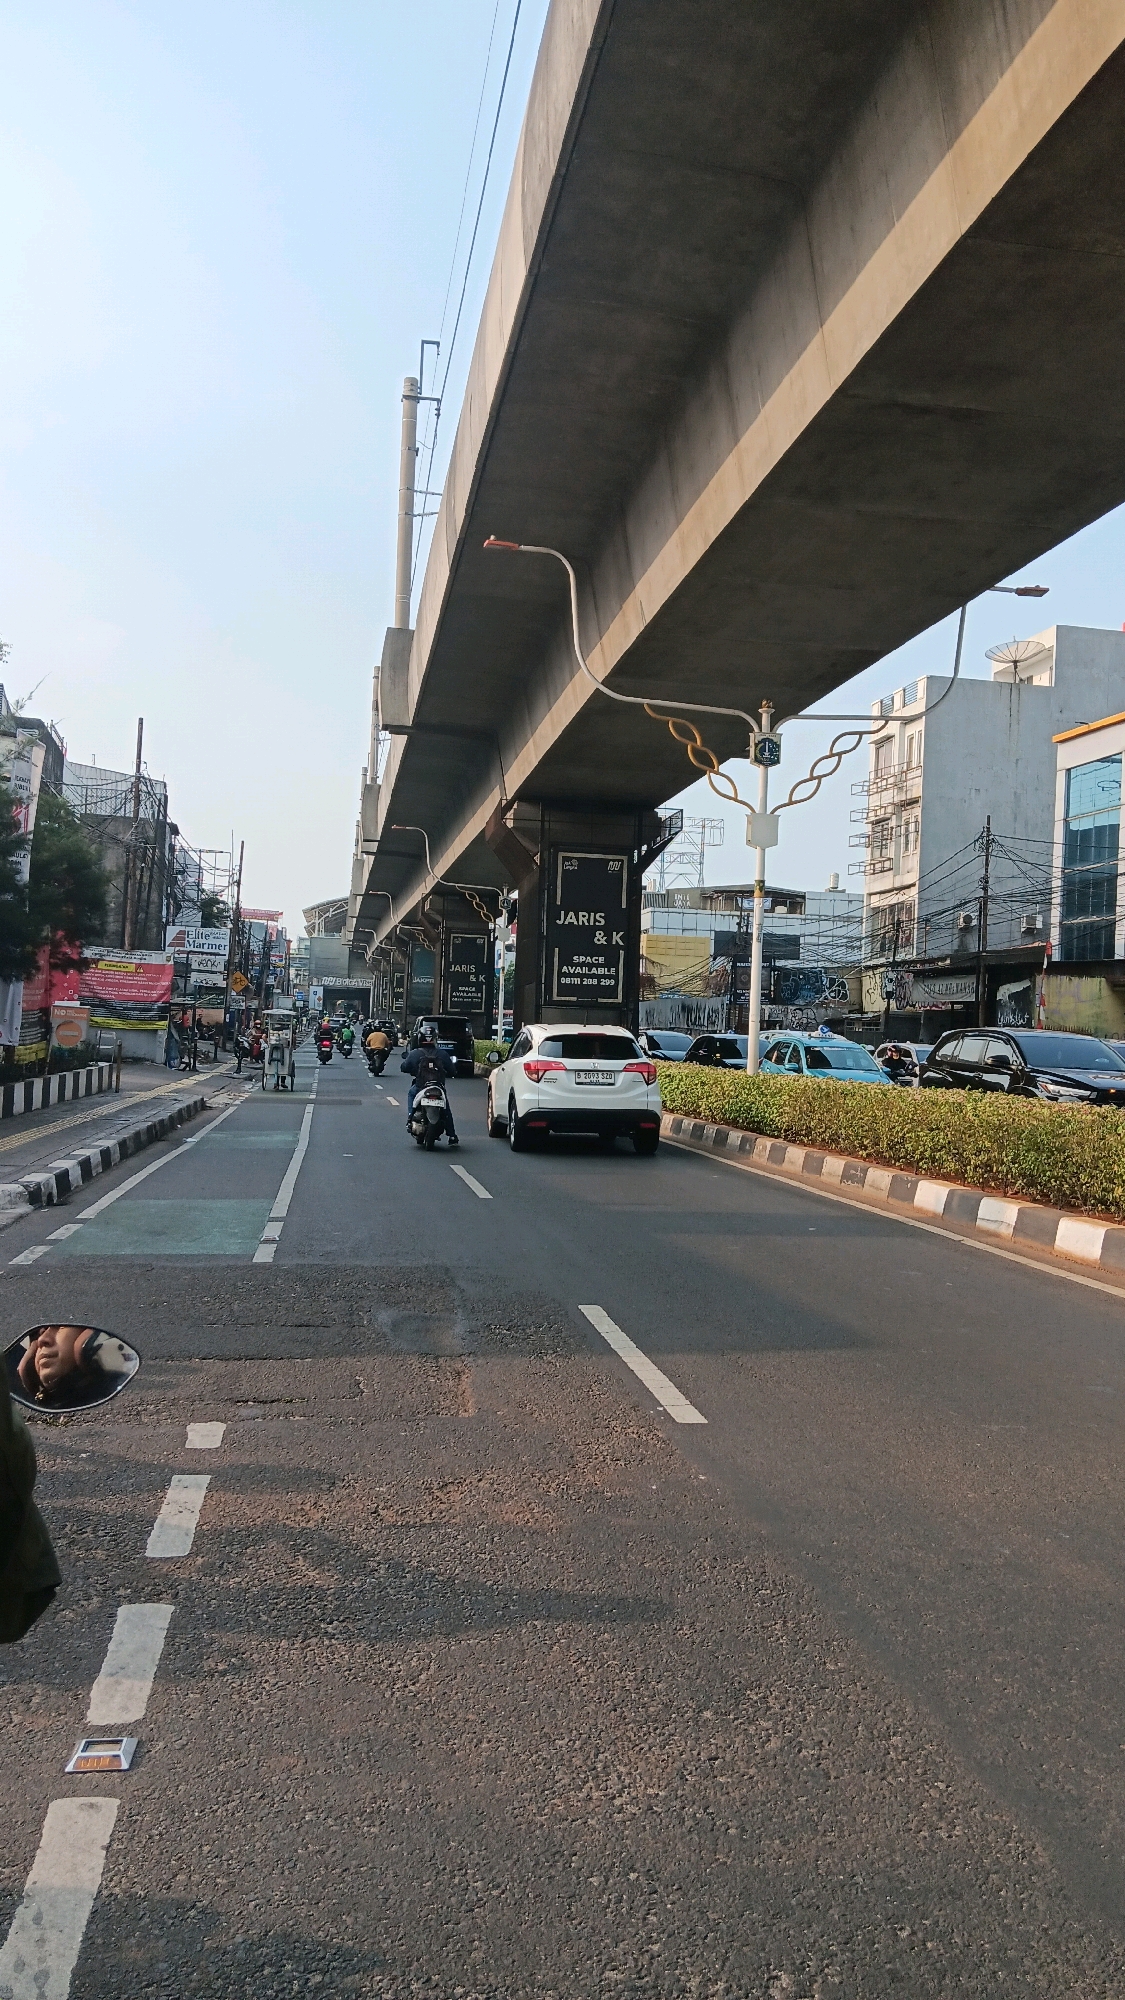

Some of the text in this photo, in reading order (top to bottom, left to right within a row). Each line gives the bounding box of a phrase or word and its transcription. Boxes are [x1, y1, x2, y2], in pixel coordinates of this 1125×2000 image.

[556, 911, 605, 925] JARIS
[186, 928, 210, 941] Elite
[593, 930, 624, 945] & K
[185, 940, 228, 950] Marmer
[572, 956, 604, 964] SPACE
[561, 966, 616, 975] AVAILABLE
[469, 974, 476, 982] &
[583, 1072, 600, 1080] 2093
